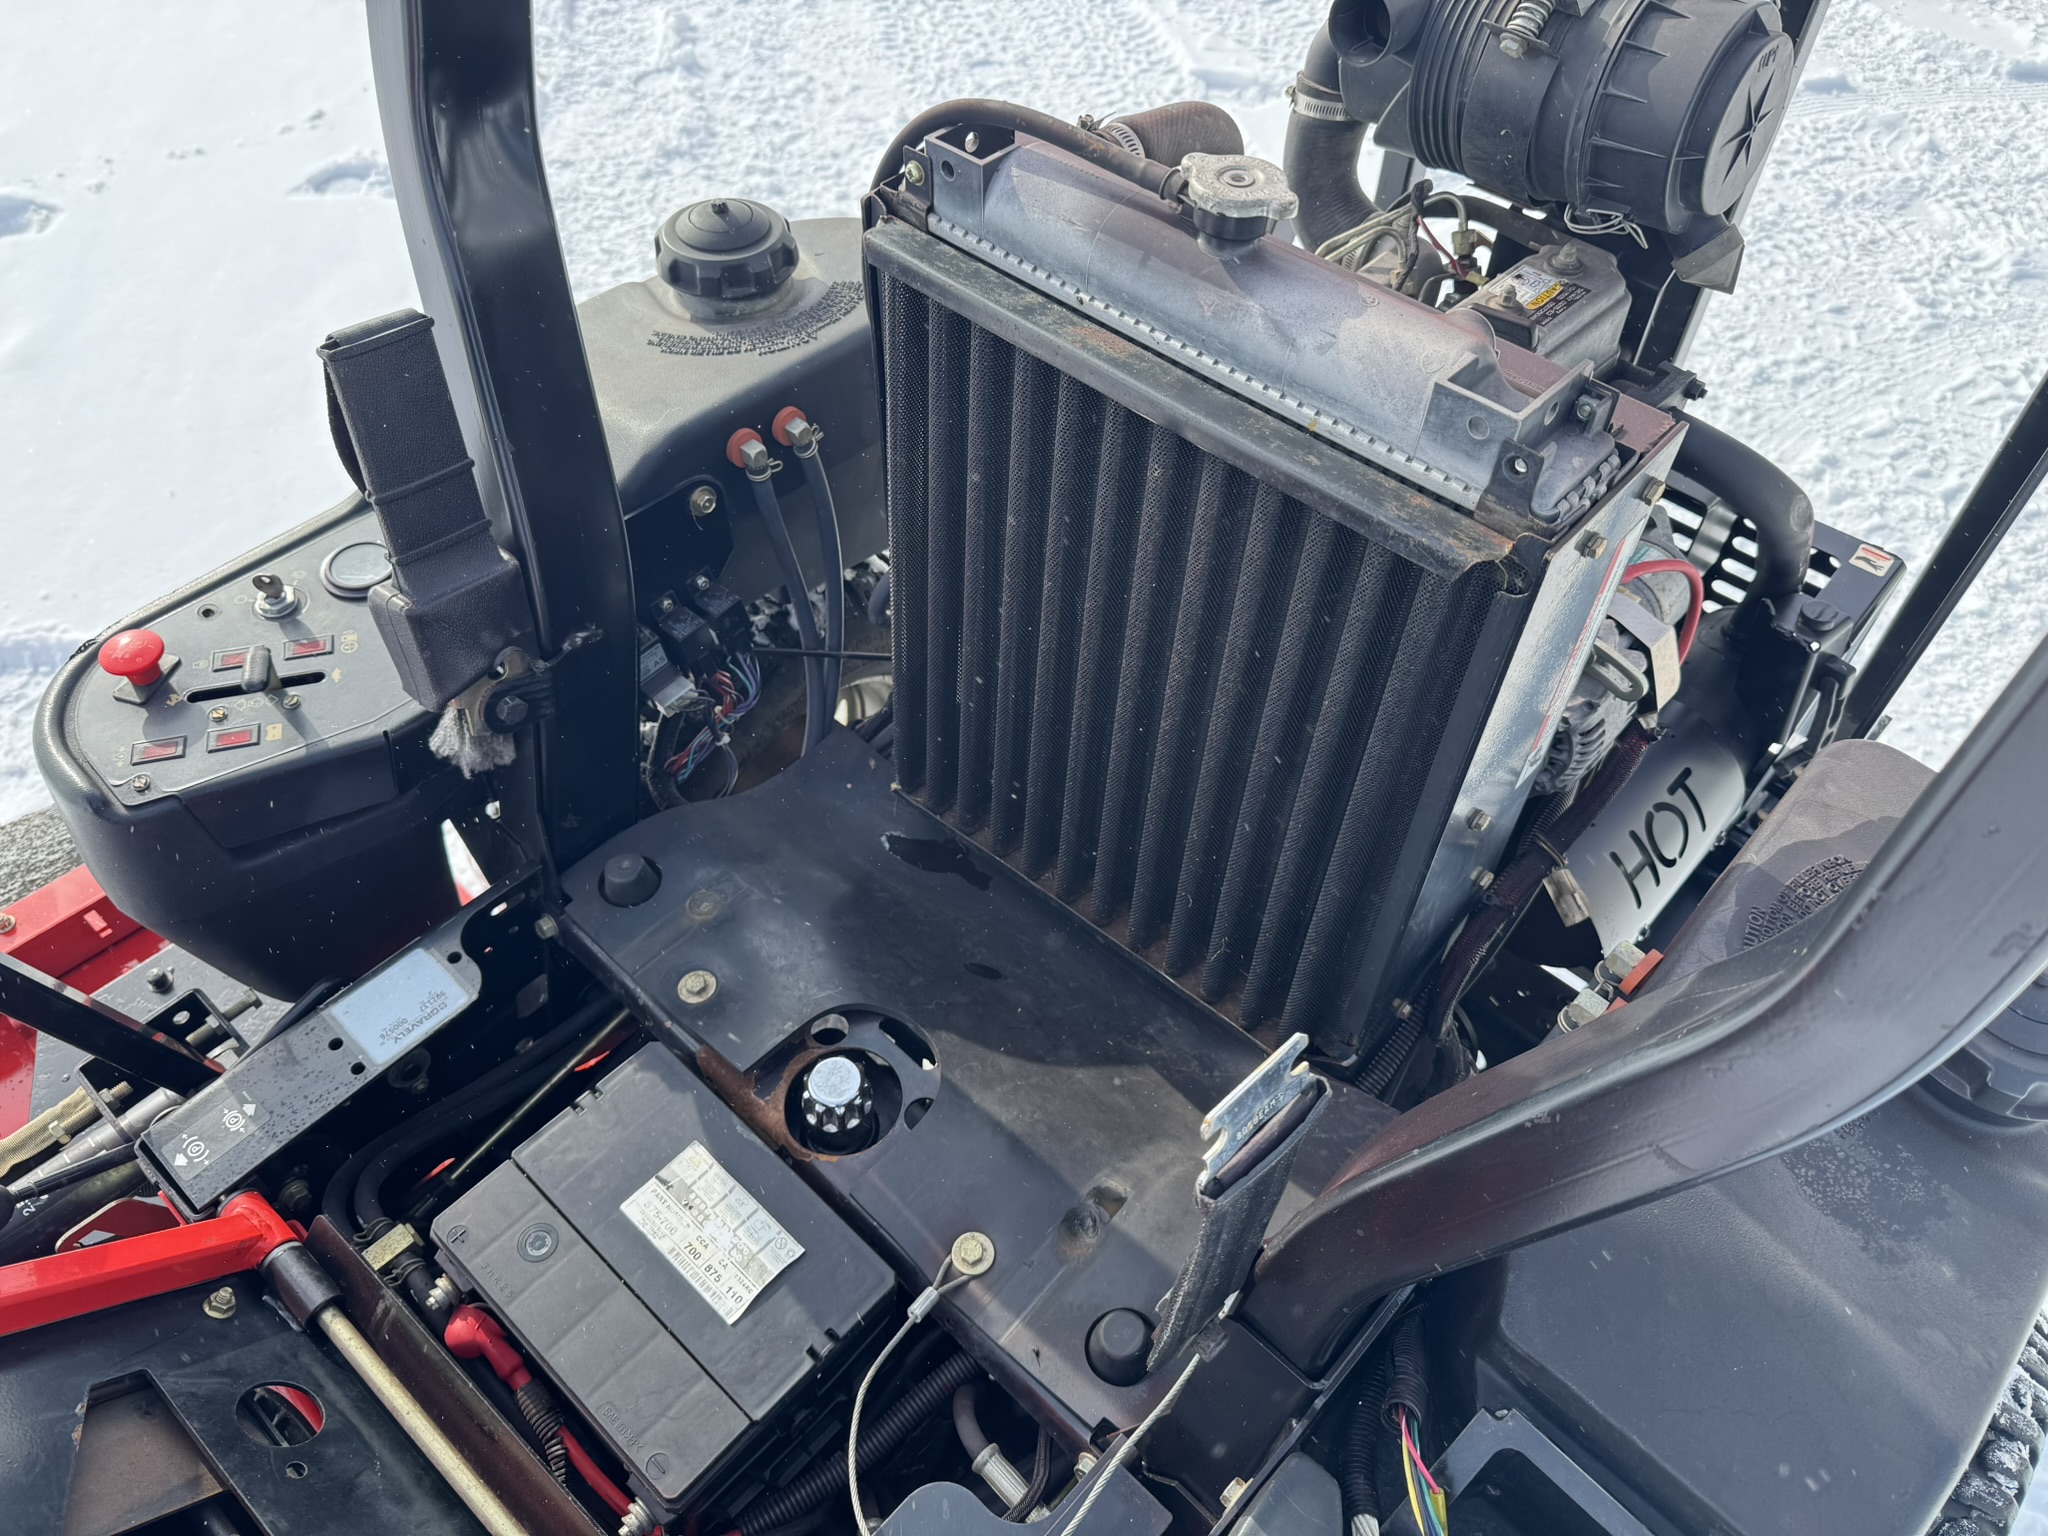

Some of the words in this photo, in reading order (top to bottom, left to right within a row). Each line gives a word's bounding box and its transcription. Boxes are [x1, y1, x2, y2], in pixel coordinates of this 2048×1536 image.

[1609, 766, 1707, 909] HOT
[1743, 906, 1766, 948] AUTION
[378, 1016, 408, 1040] 000576
[393, 1006, 440, 1044] GRAVELY
[682, 1240, 702, 1261] 700
[694, 1233, 710, 1250] CCA
[702, 1262, 723, 1284] 875
[717, 1257, 729, 1270] CA
[723, 1284, 744, 1305] 110
